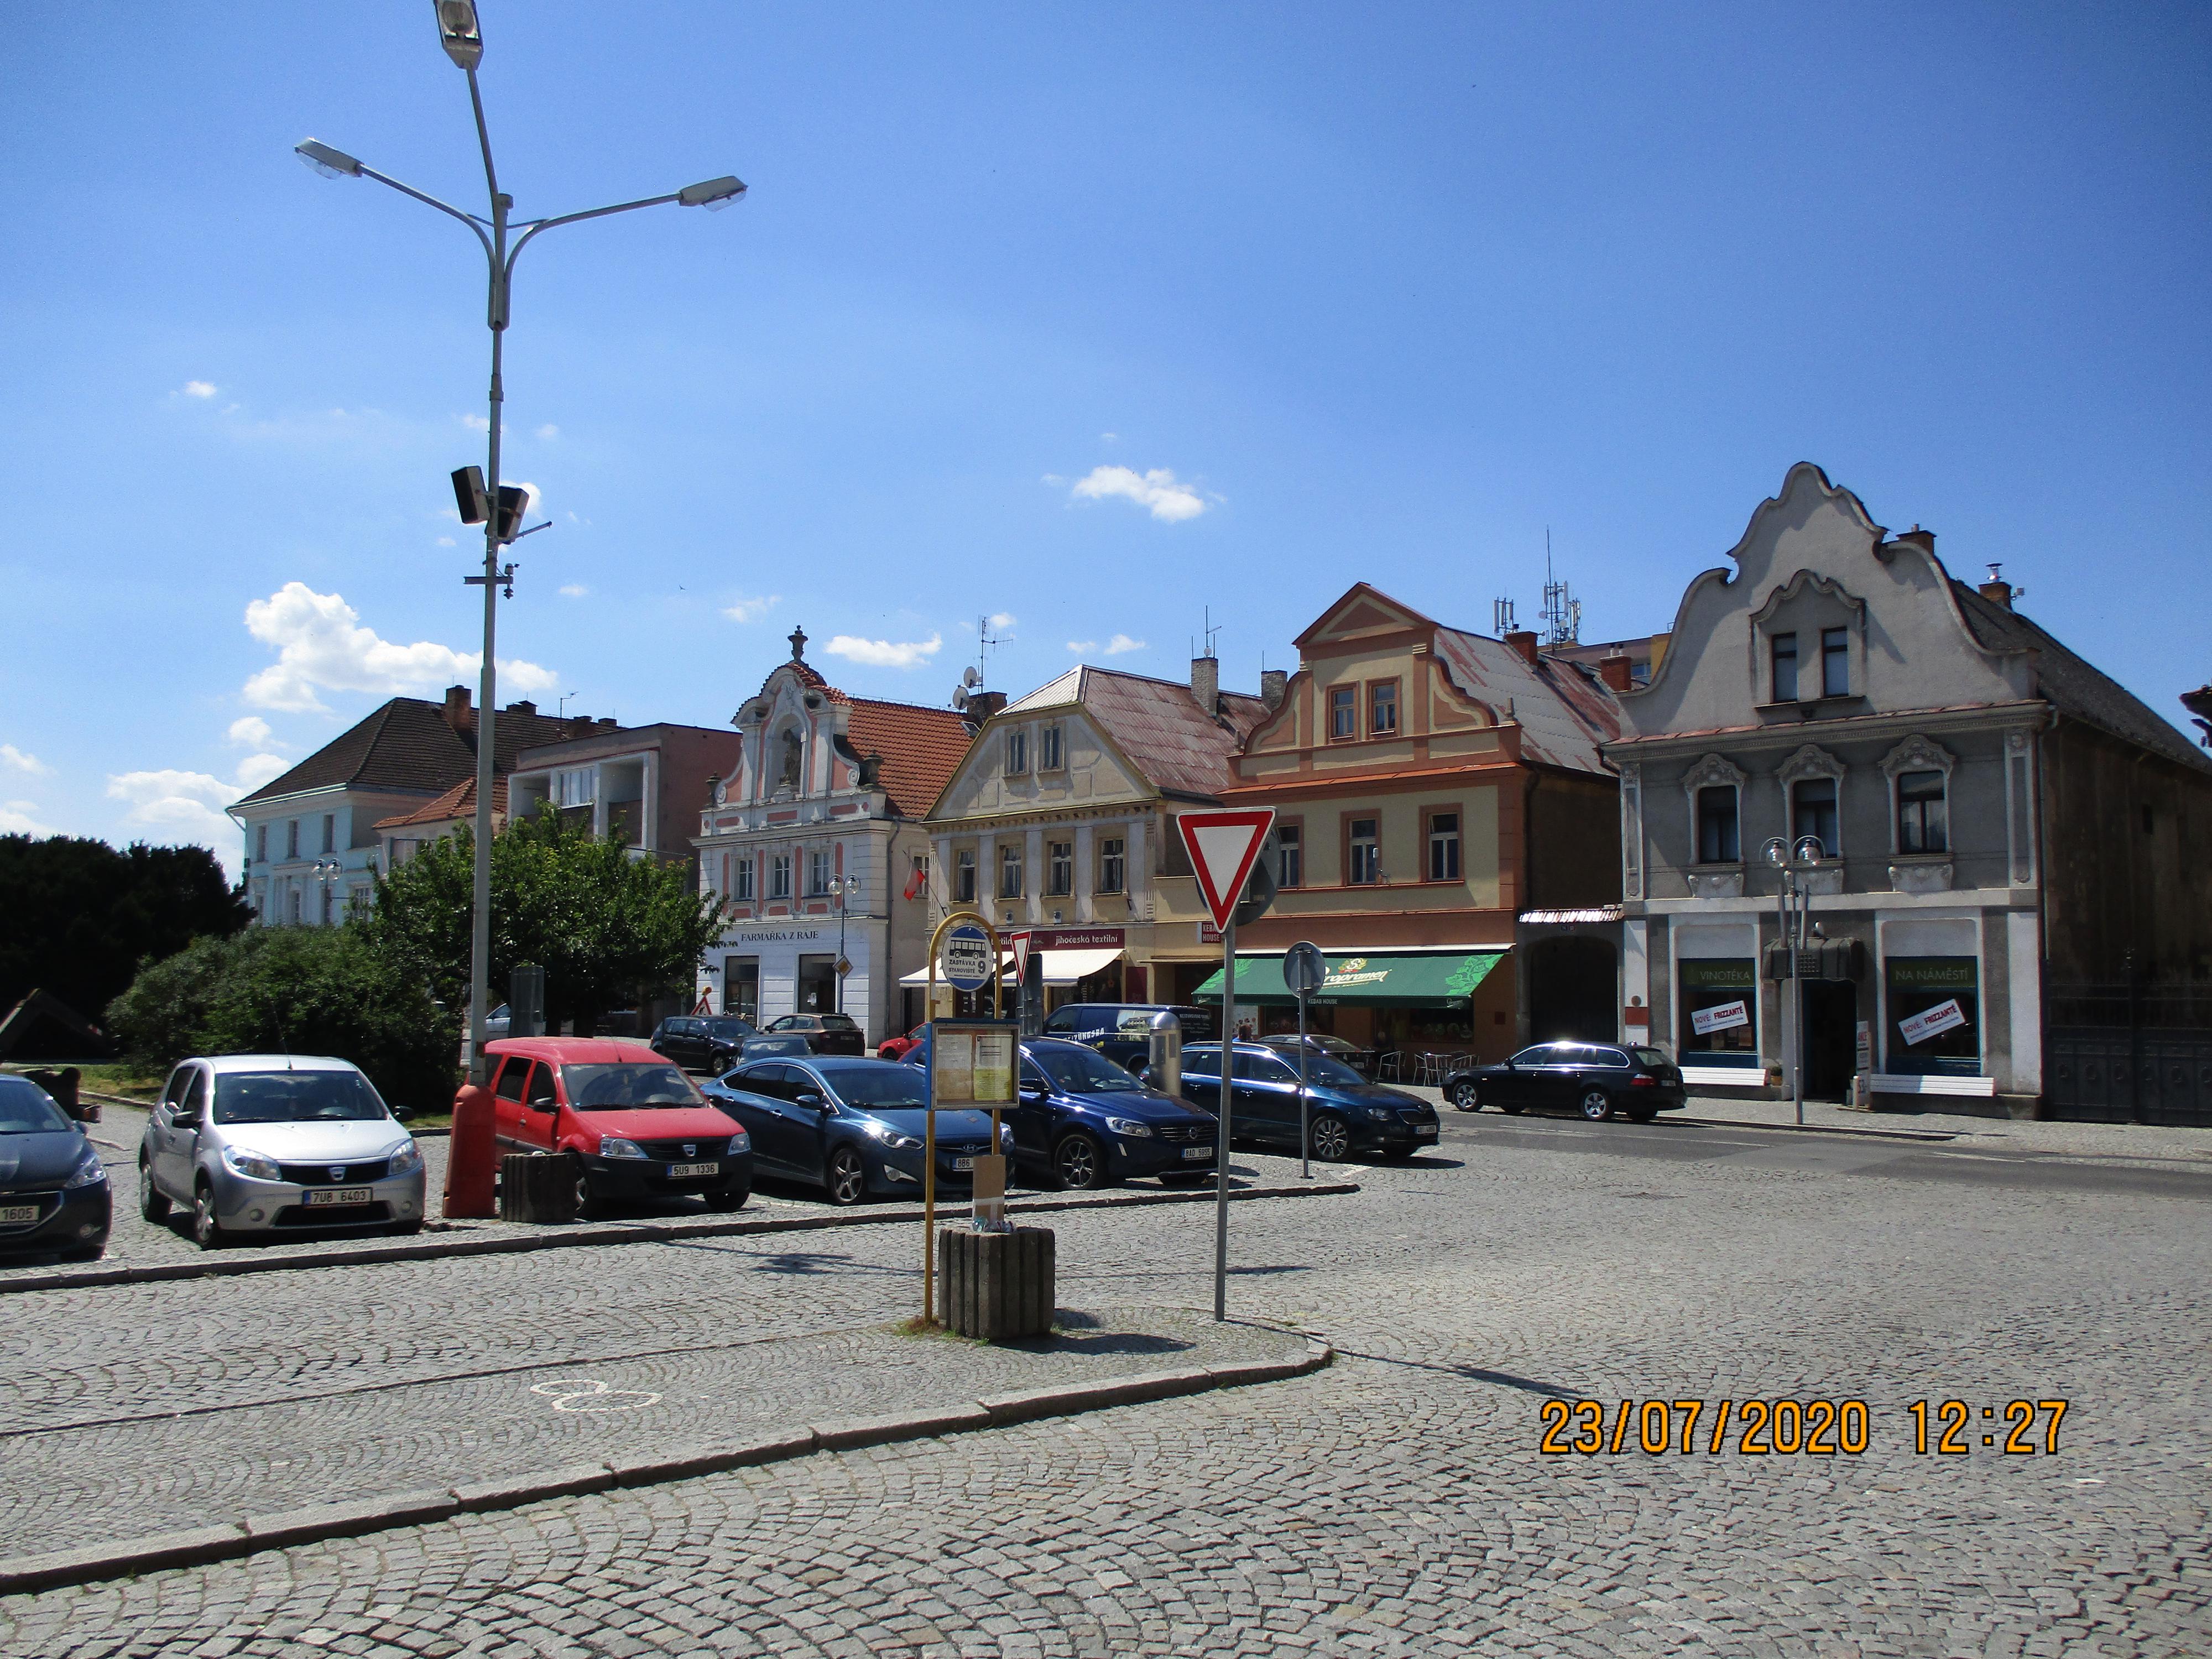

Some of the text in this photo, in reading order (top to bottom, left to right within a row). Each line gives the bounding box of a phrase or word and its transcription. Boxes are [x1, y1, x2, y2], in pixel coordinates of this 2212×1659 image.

[797, 930, 818, 939] RÁJE
[1055, 934, 1118, 946] jihočeská textilní
[978, 961, 986, 973] 9
[1700, 969, 1751, 980] VINOTÉKA
[1896, 968, 1969, 980] NA NÁMĚSTÍ
[674, 1164, 714, 1175] 5U9 1336
[340, 1191, 366, 1201] 6403
[3, 1208, 33, 1219] 1605
